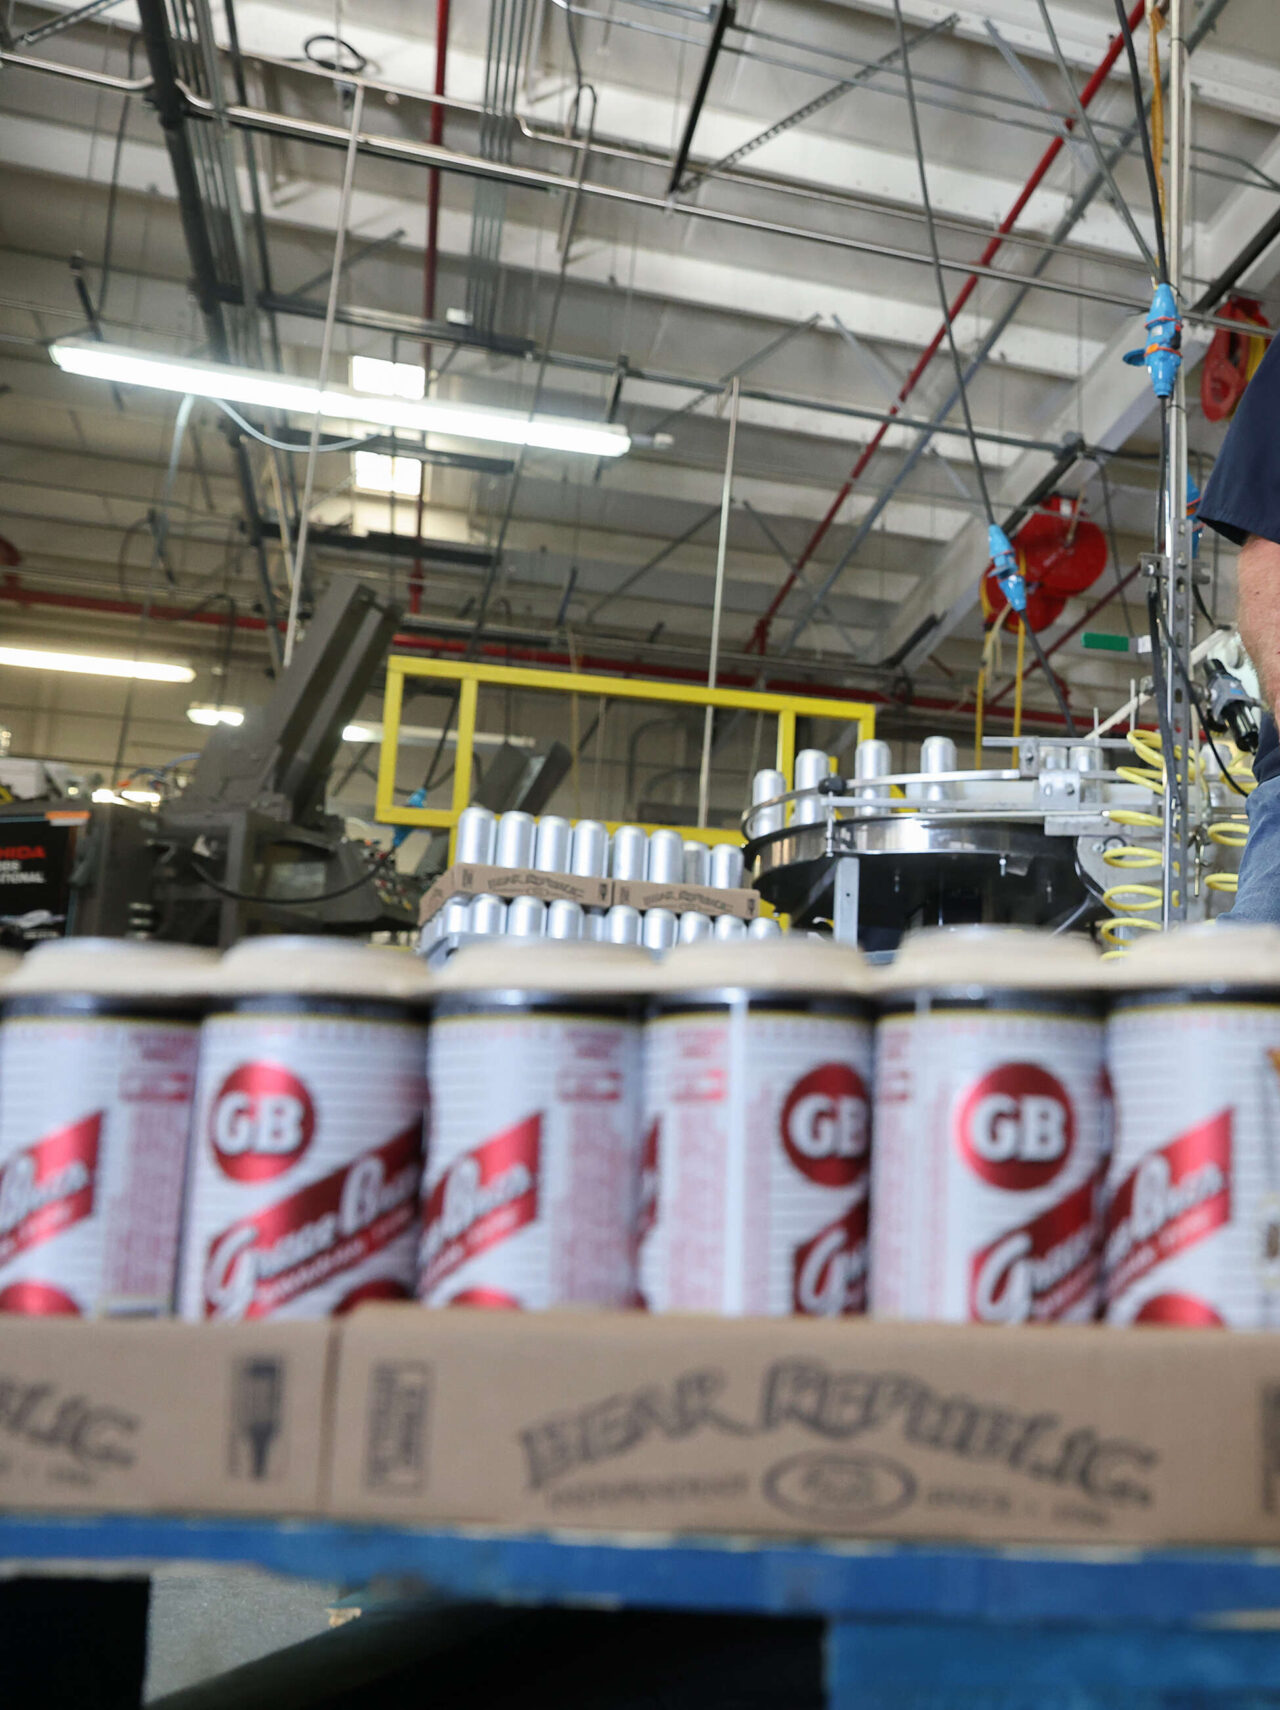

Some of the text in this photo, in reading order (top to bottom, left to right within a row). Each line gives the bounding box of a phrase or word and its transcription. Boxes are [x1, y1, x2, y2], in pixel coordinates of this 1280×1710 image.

[215, 1091, 305, 1156] GB
[968, 1093, 1069, 1162] GB
[518, 1368, 758, 1494] BEAR
[752, 1355, 1163, 1508] REPUBLIC
